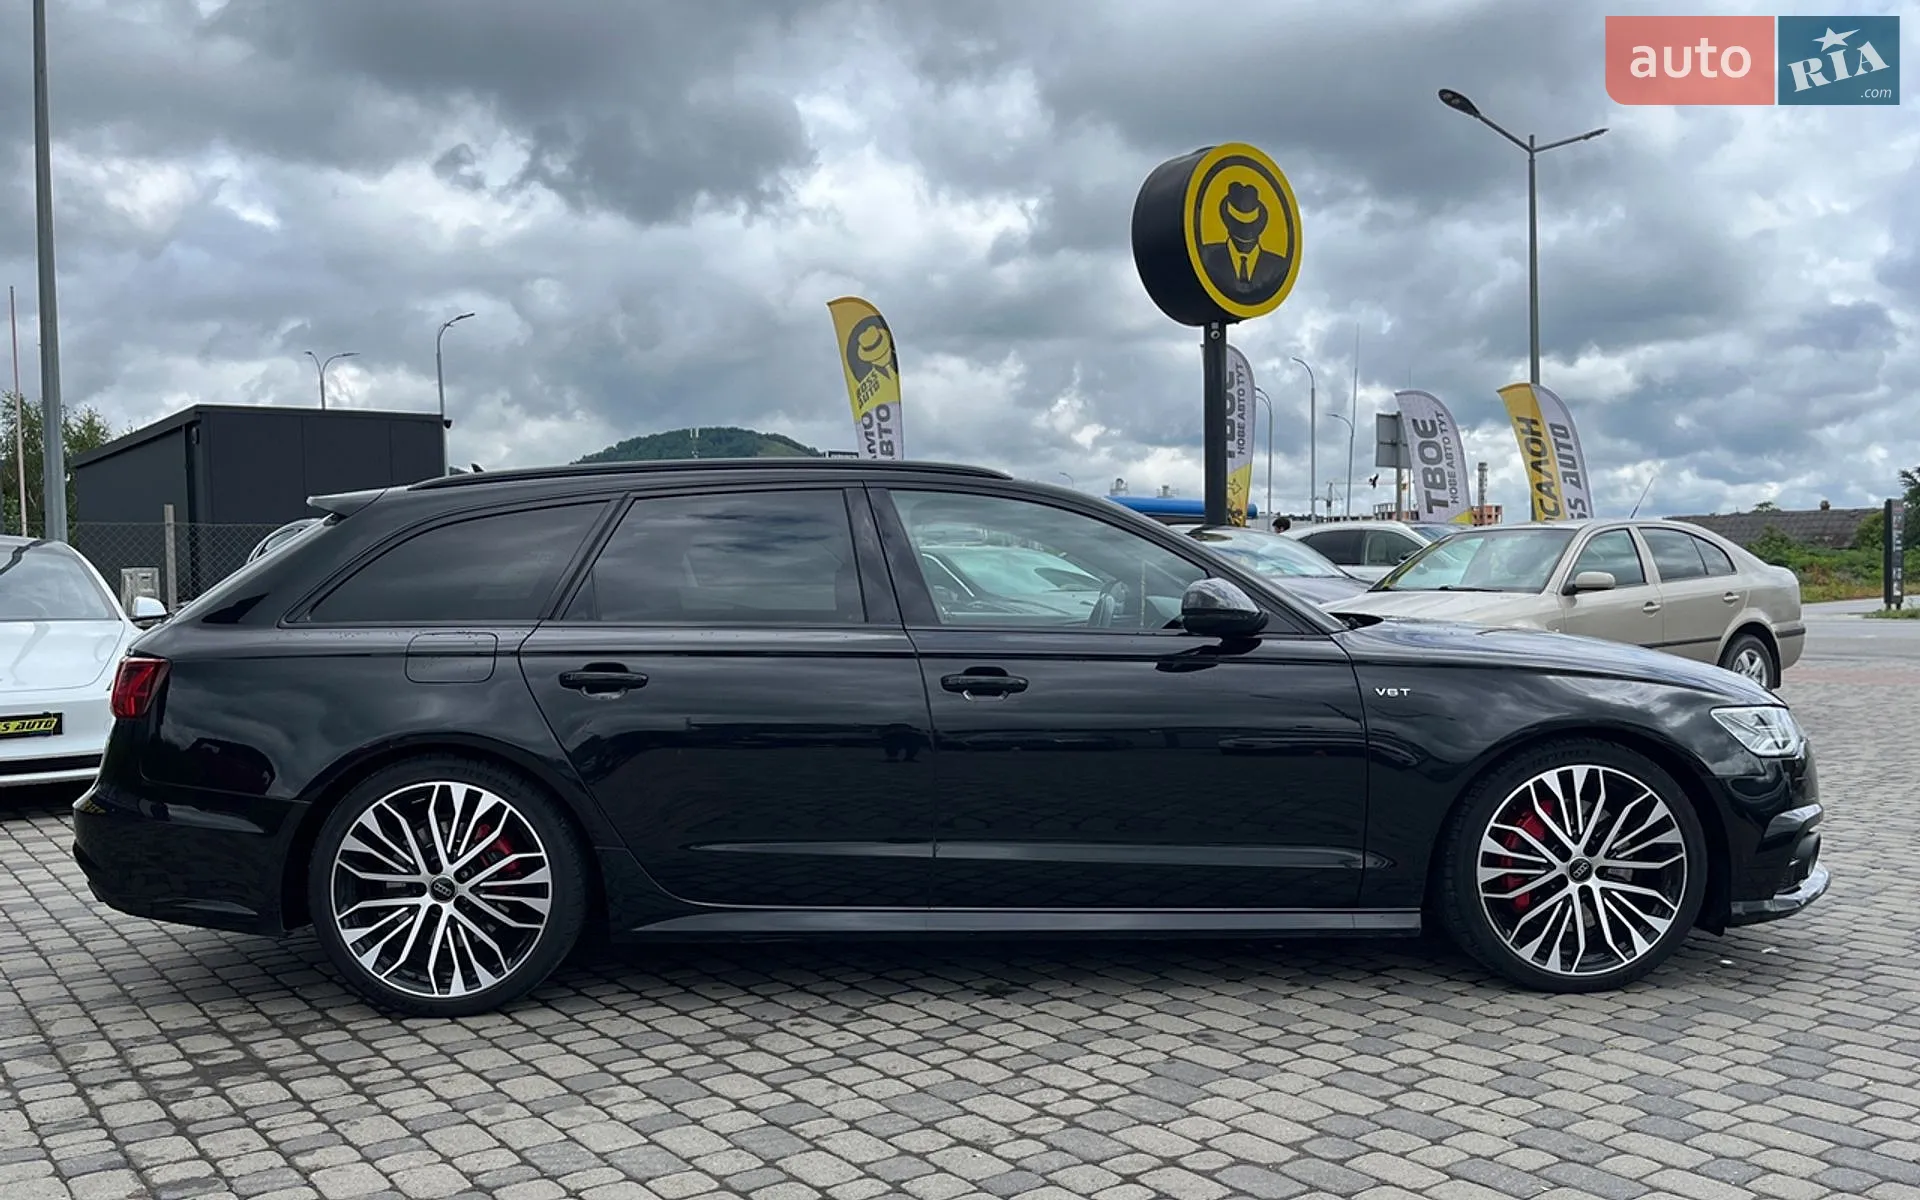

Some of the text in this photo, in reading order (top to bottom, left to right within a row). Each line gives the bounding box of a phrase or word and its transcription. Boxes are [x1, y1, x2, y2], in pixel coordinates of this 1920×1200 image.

[861, 411, 878, 459] МО
[876, 403, 895, 459] ВТО
[1435, 410, 1449, 435] ТУТ
[1442, 436, 1455, 469] АВТО
[1516, 416, 1561, 520] САЛОН
[1375, 687, 1412, 697] V6T
[15, 719, 56, 731] AUTO
